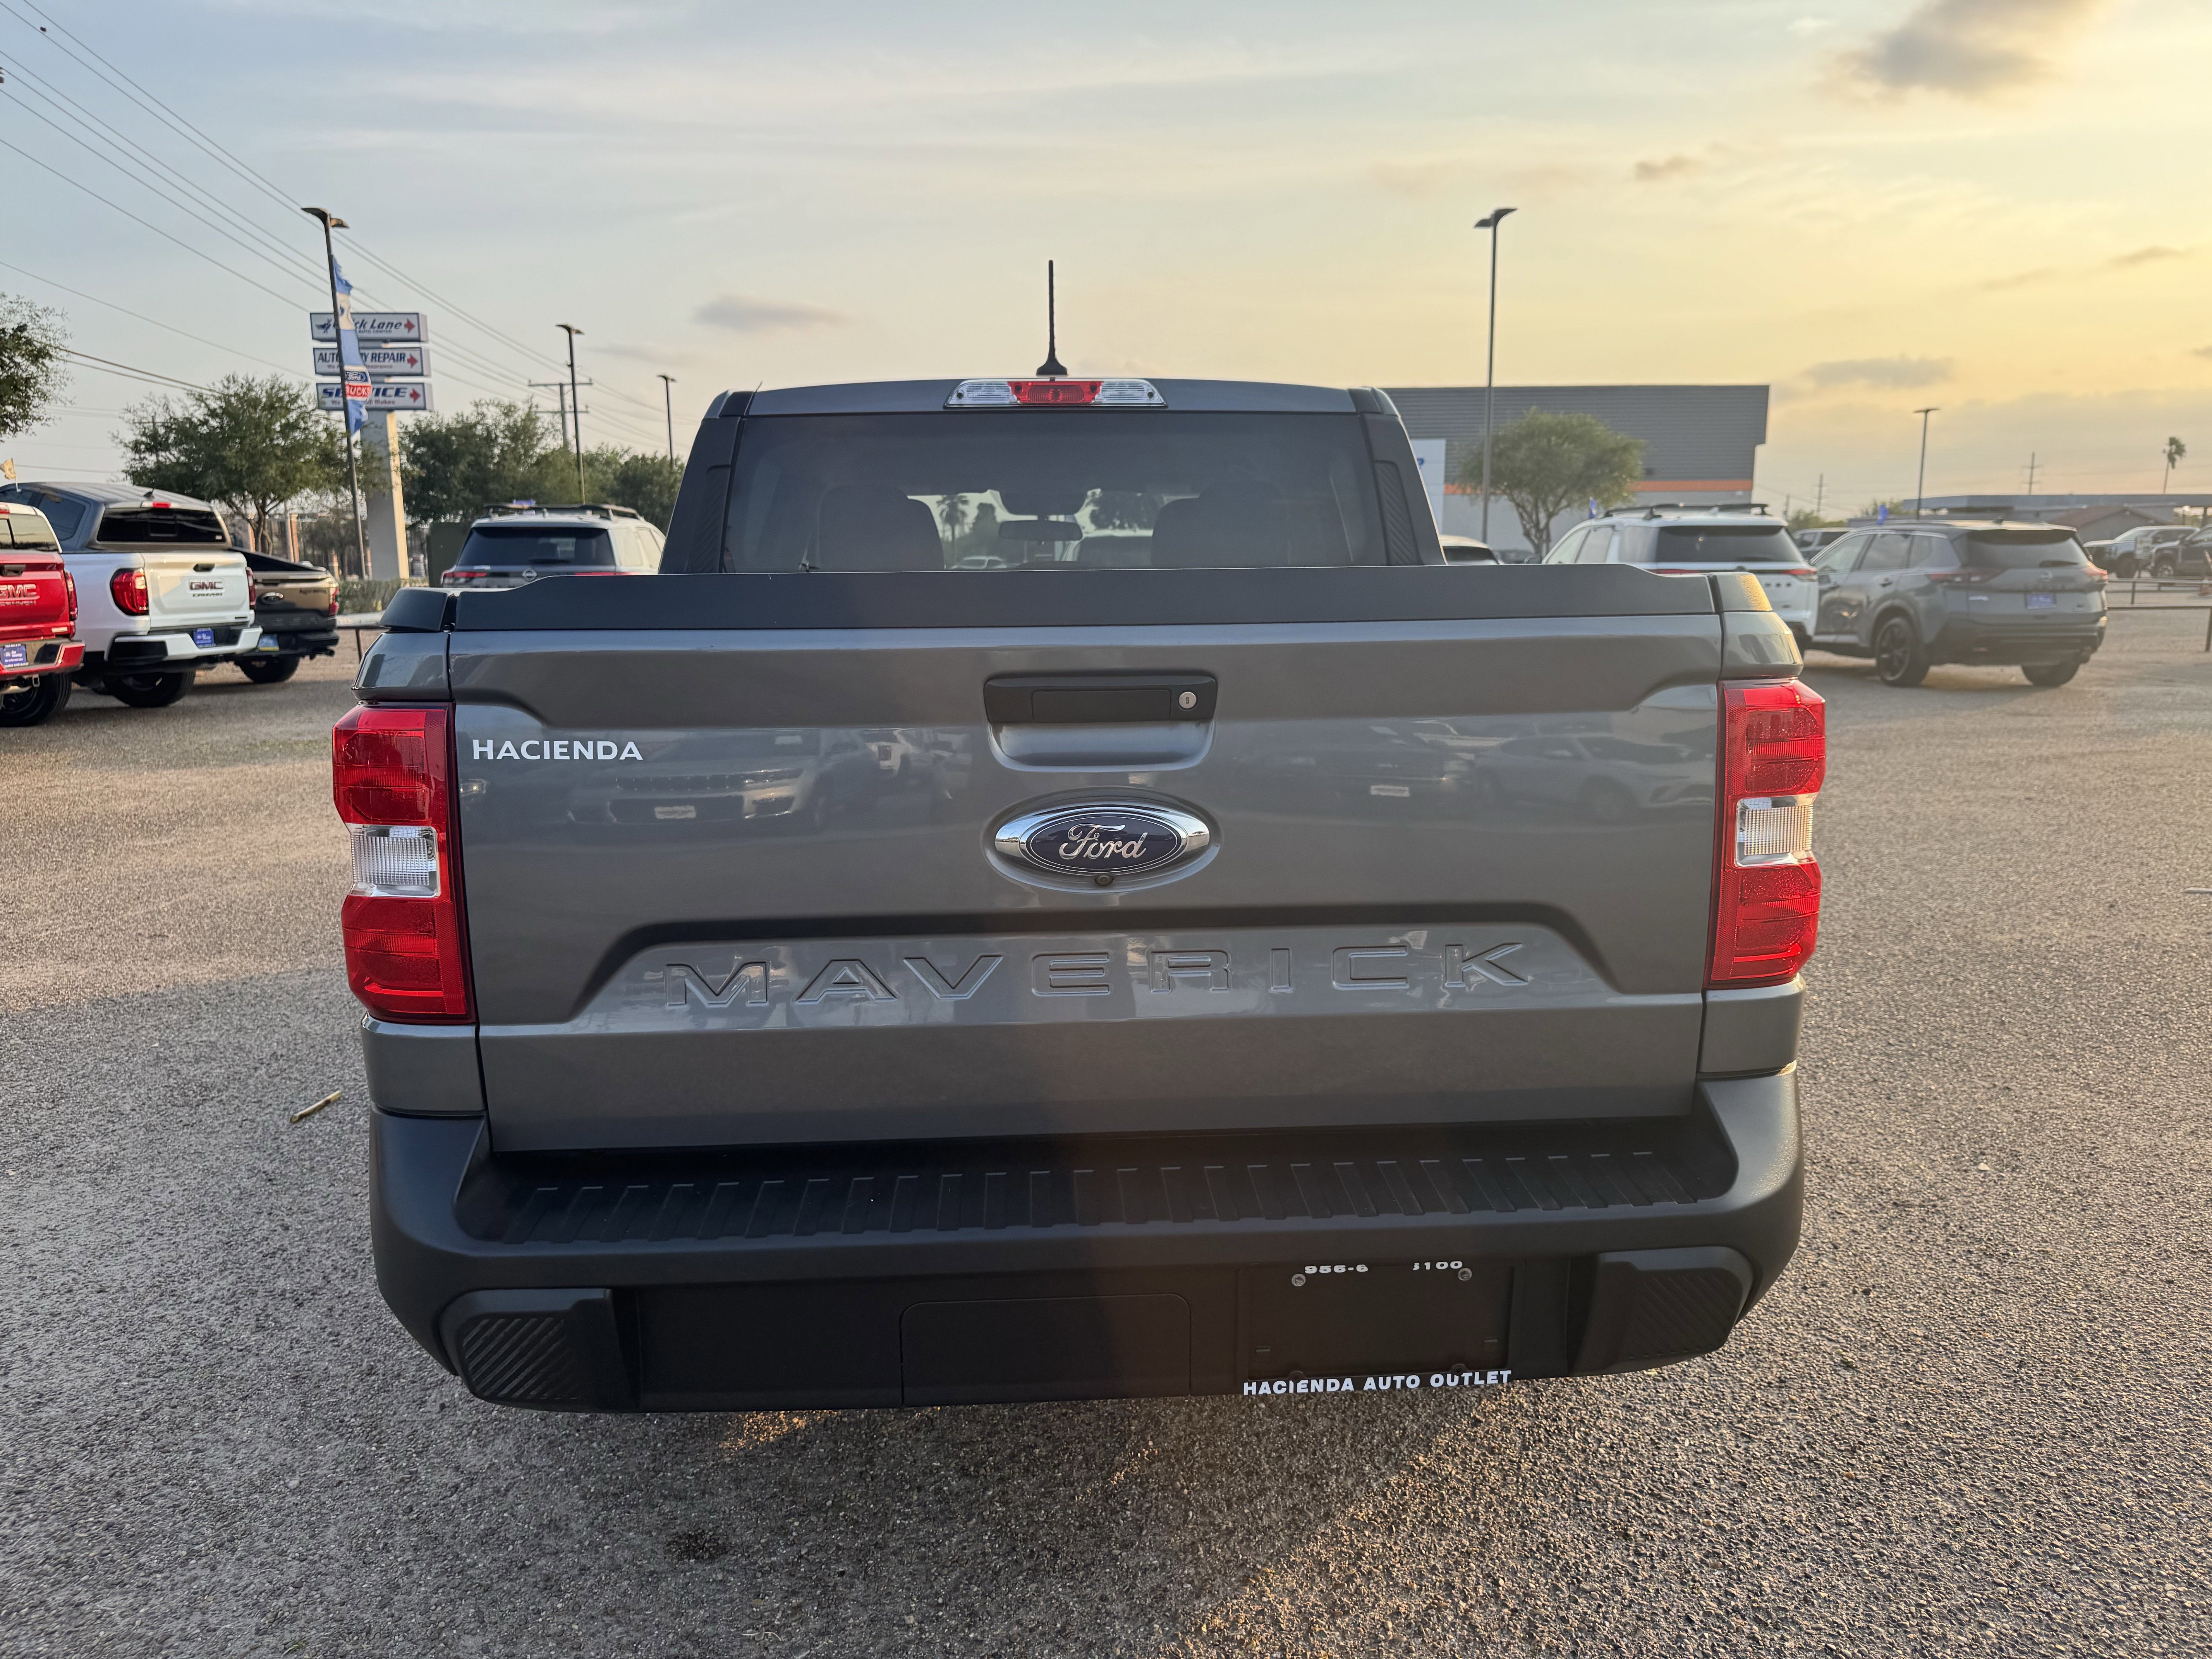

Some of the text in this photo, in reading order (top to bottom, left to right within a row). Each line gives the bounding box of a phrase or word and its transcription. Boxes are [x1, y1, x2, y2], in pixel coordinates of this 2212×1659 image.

[370, 318, 402, 330] Lane
[371, 352, 406, 363] REPAIR
[322, 387, 407, 398] SEICE
[190, 581, 223, 590] GMC
[473, 739, 643, 760] HACIENDA
[1059, 823, 1149, 860] Ford
[665, 943, 1529, 1006] MAVERICK
[1243, 1370, 1511, 1395] HACIENDA AUTO OUTLET
